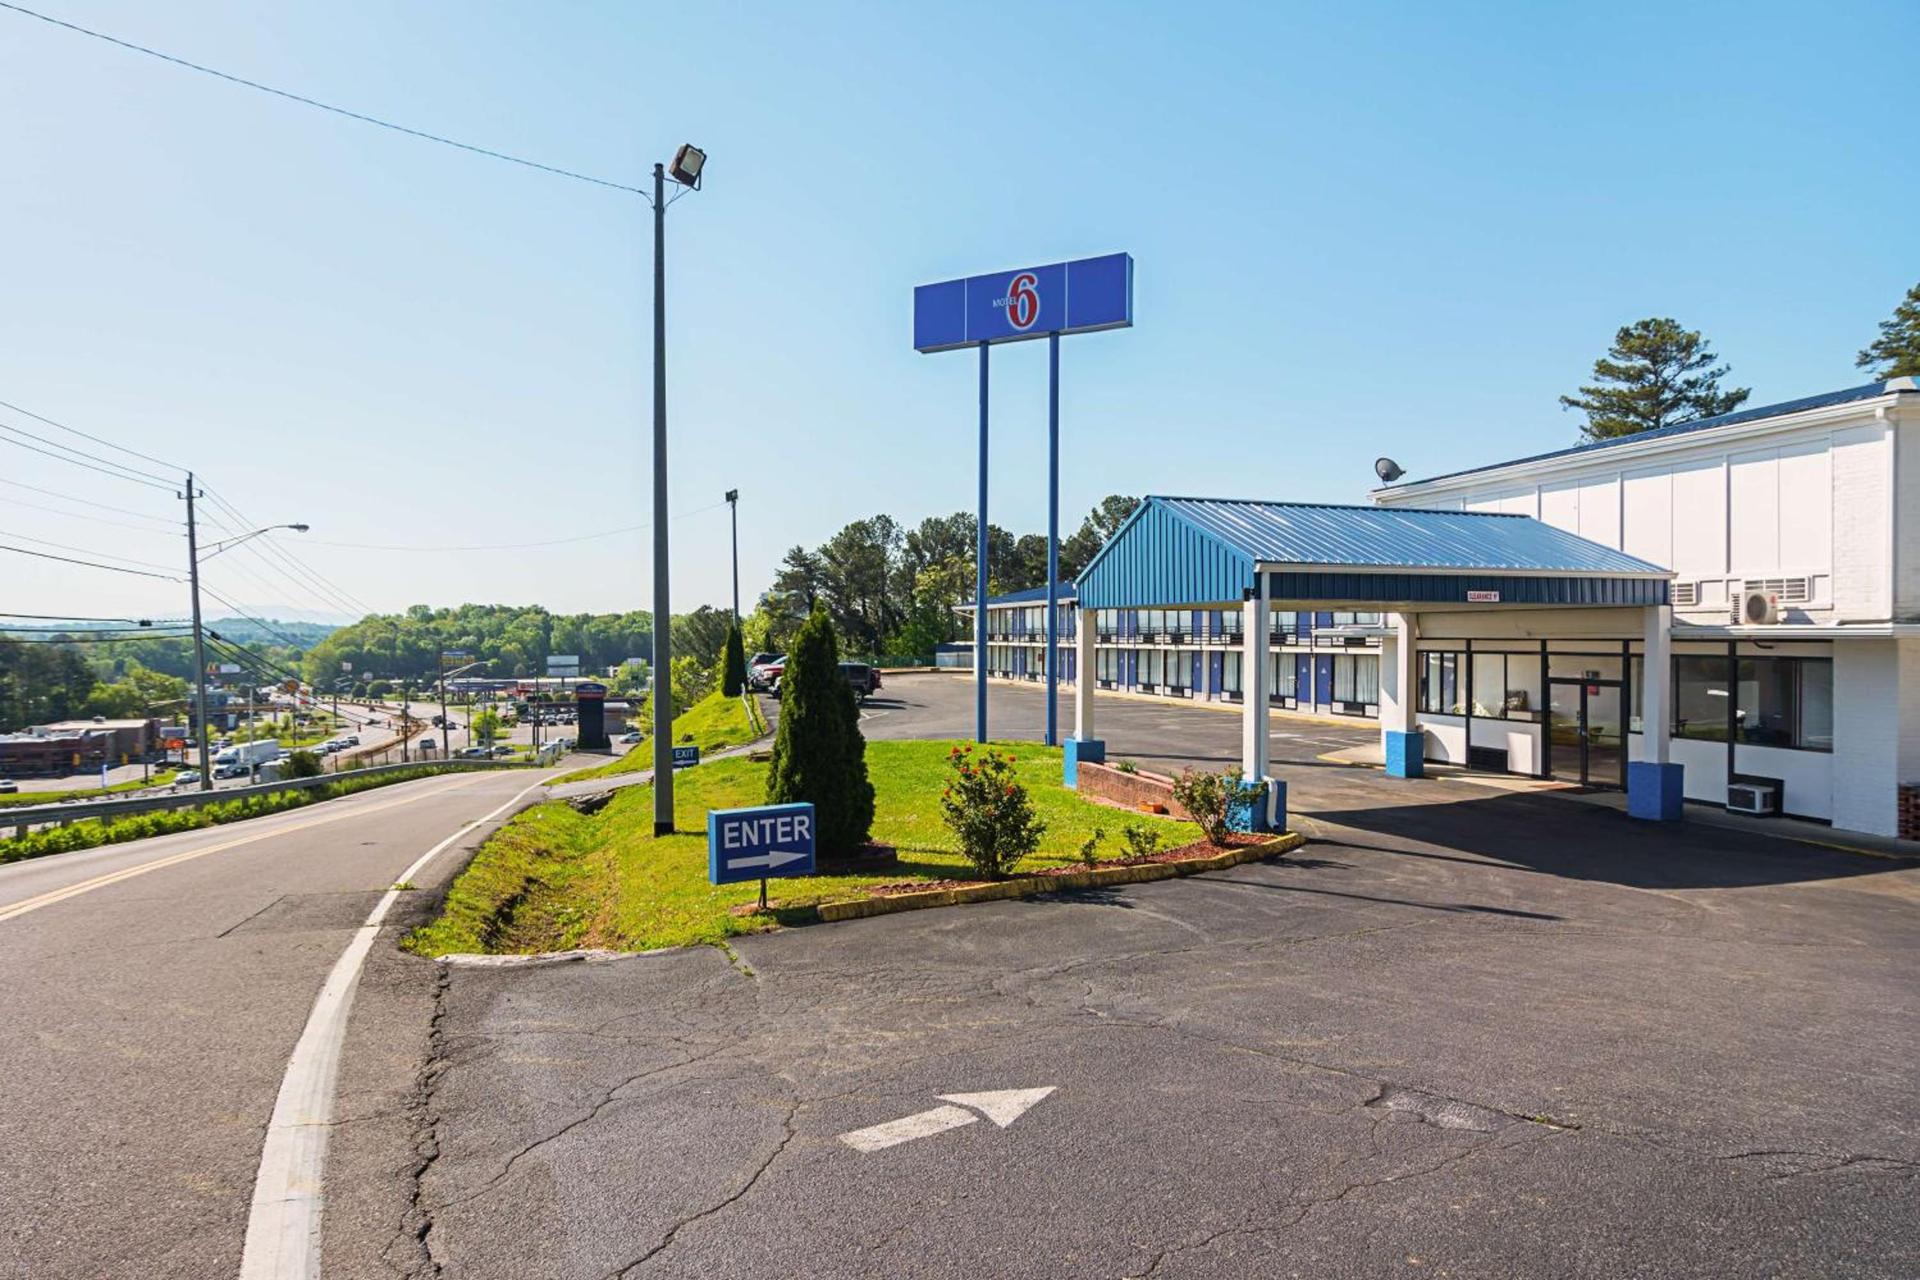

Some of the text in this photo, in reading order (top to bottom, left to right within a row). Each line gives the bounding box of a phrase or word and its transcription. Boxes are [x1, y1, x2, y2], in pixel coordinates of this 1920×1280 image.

[992, 272, 1038, 331] MOTEL 6
[675, 749, 694, 759] EXIT
[723, 815, 811, 849] ENTER
